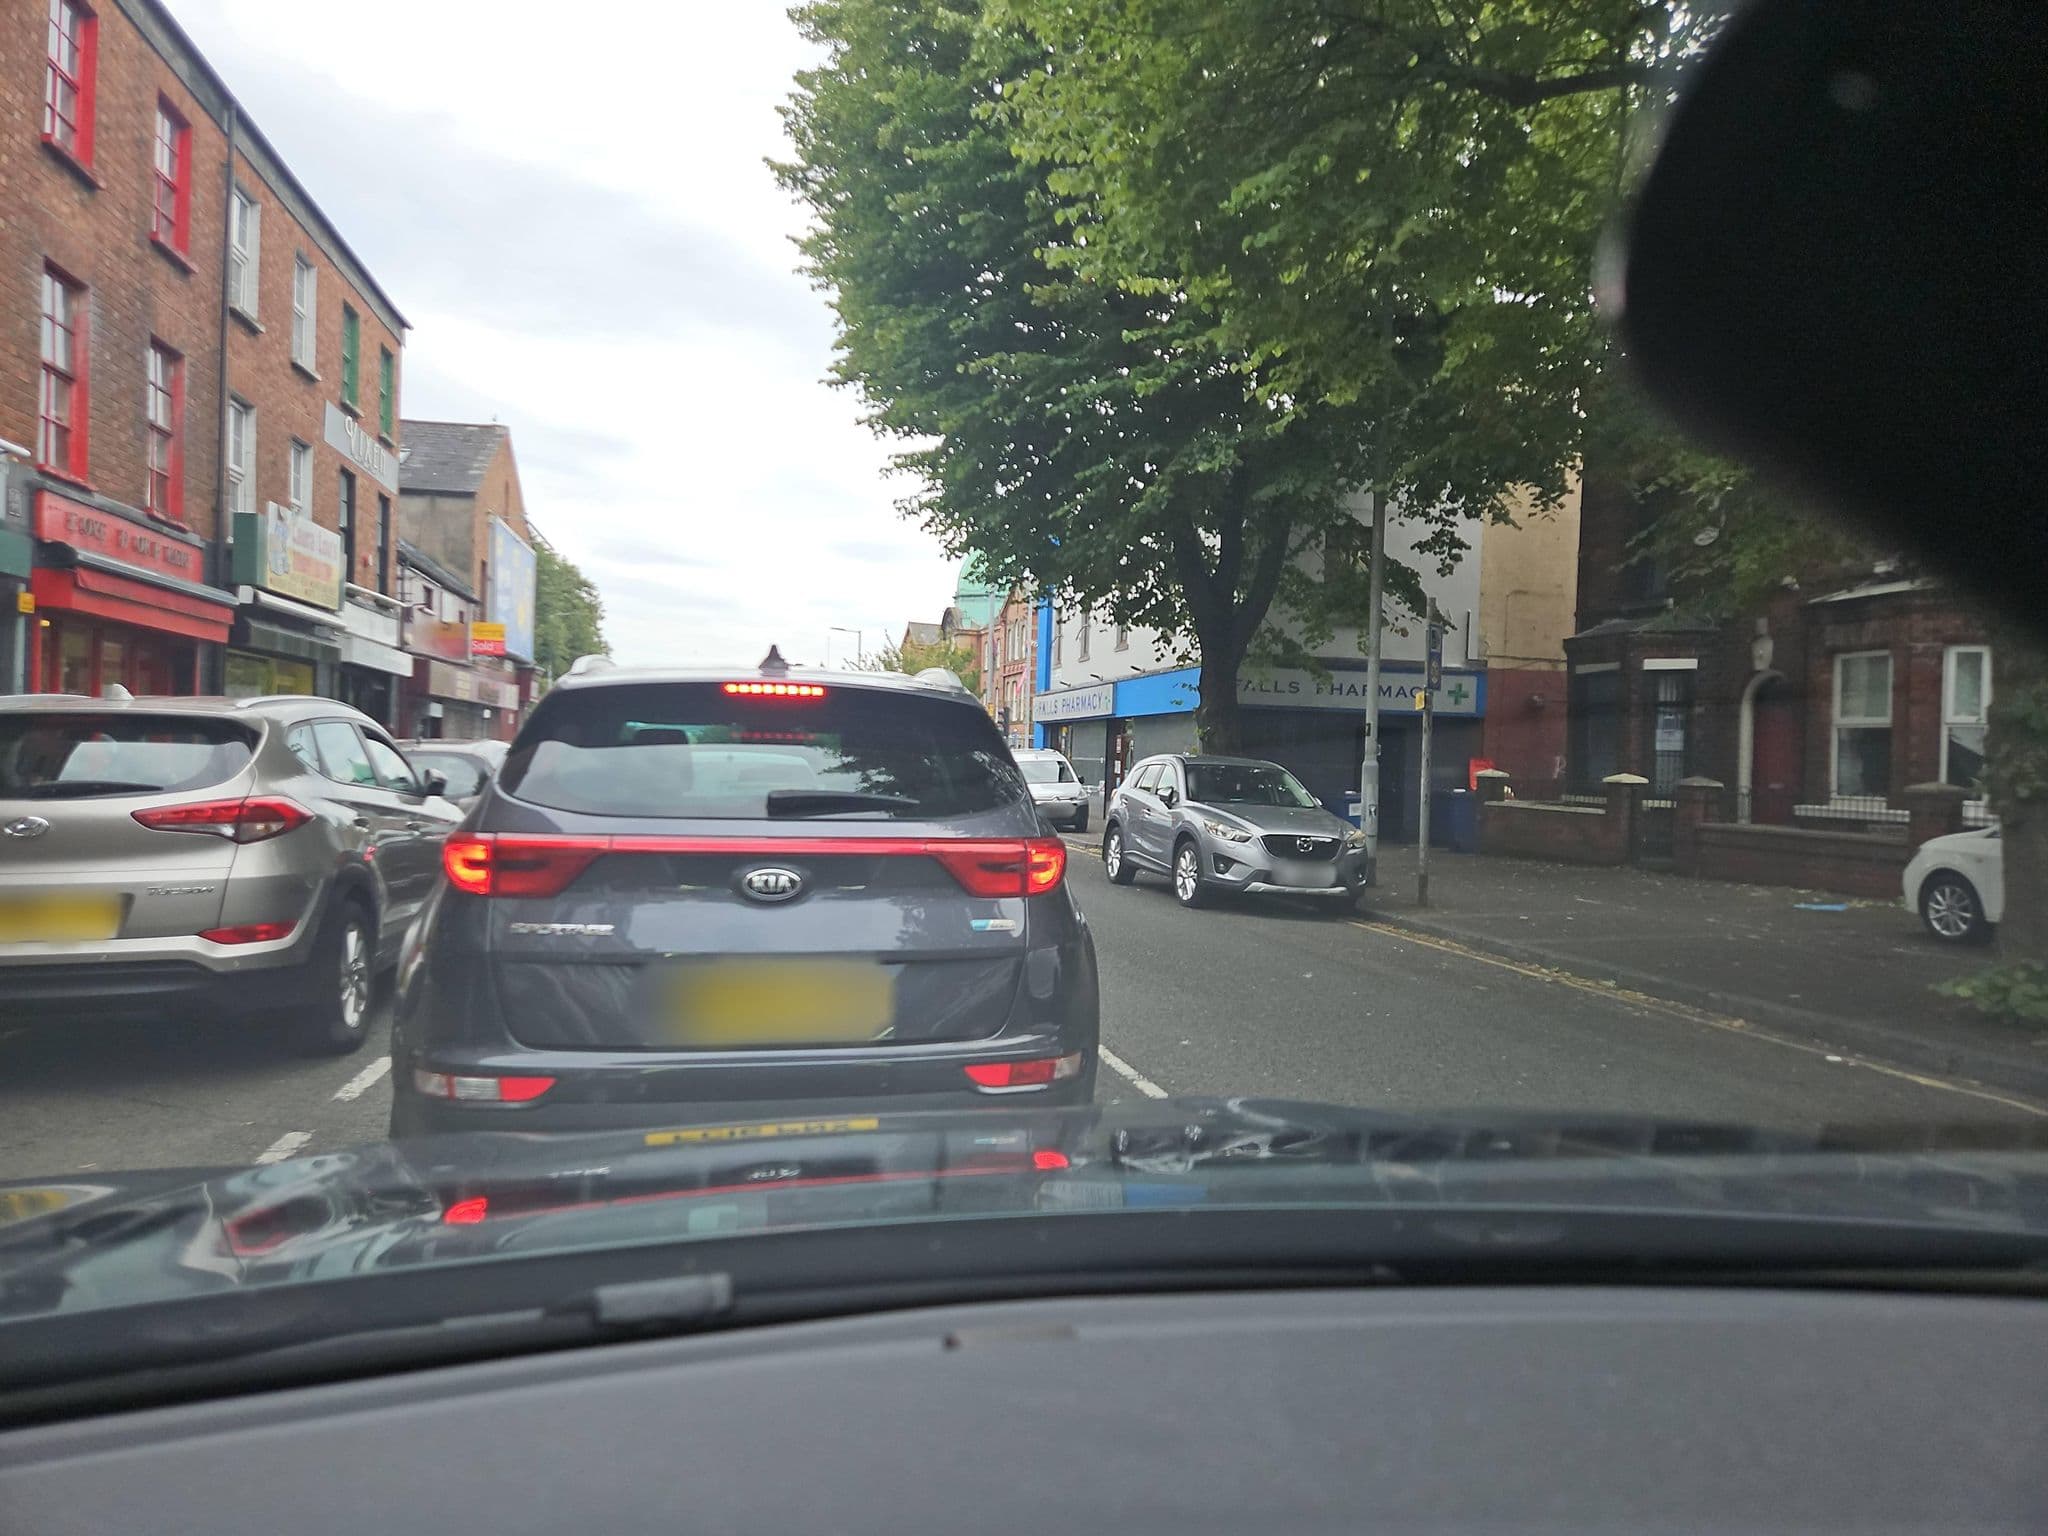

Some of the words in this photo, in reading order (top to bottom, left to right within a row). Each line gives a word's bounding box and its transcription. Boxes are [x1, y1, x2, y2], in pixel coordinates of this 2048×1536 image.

[1316, 682, 1423, 699] PHAMAC
[1062, 691, 1103, 713] PHARMACY
[751, 874, 793, 894] KIA
